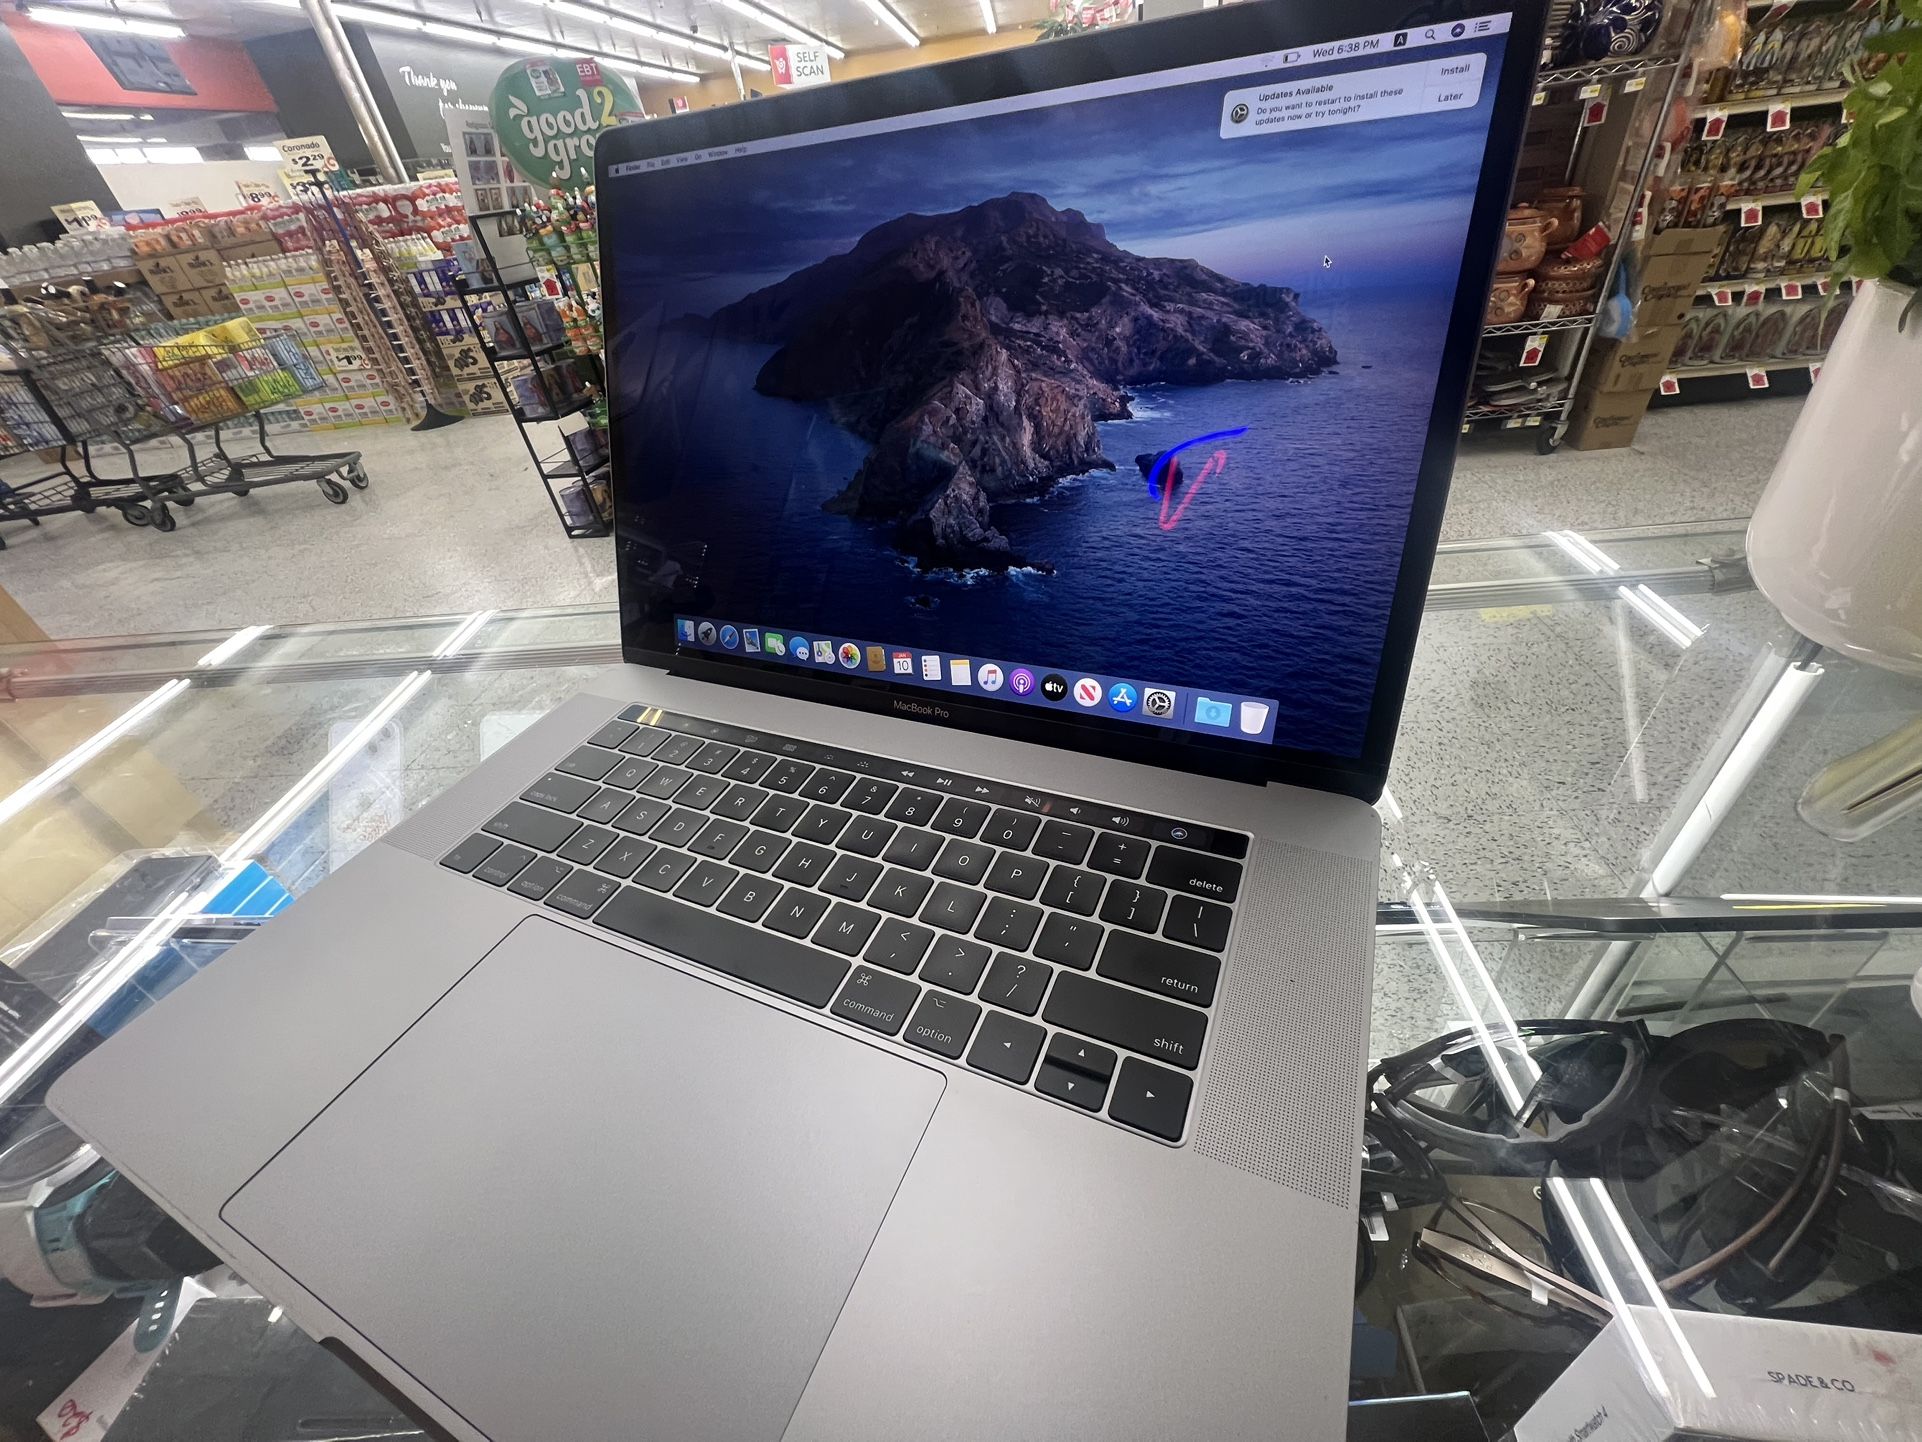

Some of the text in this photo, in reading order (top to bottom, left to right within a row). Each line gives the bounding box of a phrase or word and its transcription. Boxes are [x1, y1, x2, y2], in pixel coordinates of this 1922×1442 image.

[1313, 38, 1380, 58] Wed 6:38 PM
[796, 51, 820, 63] SELF
[575, 63, 598, 76] EBT
[796, 64, 825, 77] SCAN
[1440, 64, 1471, 76] Install
[399, 66, 458, 96] Thank you
[1259, 84, 1334, 102] Updates Available
[1438, 92, 1463, 103] Later
[1257, 87, 1404, 115] Do you want to restart to install these
[1255, 115, 1285, 126] updates
[1315, 110, 1326, 119] try
[1328, 104, 1361, 116] tonight?
[521, 86, 617, 157] good 2
[282, 141, 320, 153] Coronado
[896, 660, 909, 671] 10
[893, 700, 950, 718] MacBook Pro
[703, 758, 714, 766] 3
[625, 768, 636, 777] Q
[740, 767, 751, 776] 4
[659, 776, 673, 787] W
[777, 776, 788, 785] 5
[695, 786, 707, 796] E
[818, 785, 828, 795] 6
[599, 801, 611, 810] A
[734, 796, 746, 807] R
[861, 795, 872, 805] 7
[636, 810, 648, 820] S
[775, 807, 786, 817] T
[904, 806, 916, 816] 8
[673, 822, 686, 831] D
[817, 818, 828, 828] Y
[952, 818, 963, 828] 9
[713, 833, 725, 843] F
[861, 830, 874, 840] U
[1002, 829, 1013, 840] 0
[582, 839, 595, 849] Z
[909, 842, 918, 852] I
[754, 845, 767, 855] G
[618, 851, 632, 862] X
[957, 855, 970, 867] O
[658, 864, 671, 874] C
[798, 858, 812, 869] H
[846, 871, 857, 882] J
[1010, 869, 1023, 879] P
[520, 879, 545, 893] option
[701, 876, 714, 887] V
[1189, 877, 1224, 893] delete
[743, 891, 756, 902] B
[894, 885, 908, 897] K
[556, 893, 593, 911] command
[947, 900, 956, 913] L
[790, 905, 805, 918] N
[838, 921, 855, 934] M
[1160, 975, 1200, 995] return
[842, 996, 895, 1022] command
[915, 1024, 952, 1045] option
[1152, 1036, 1185, 1055] shift
